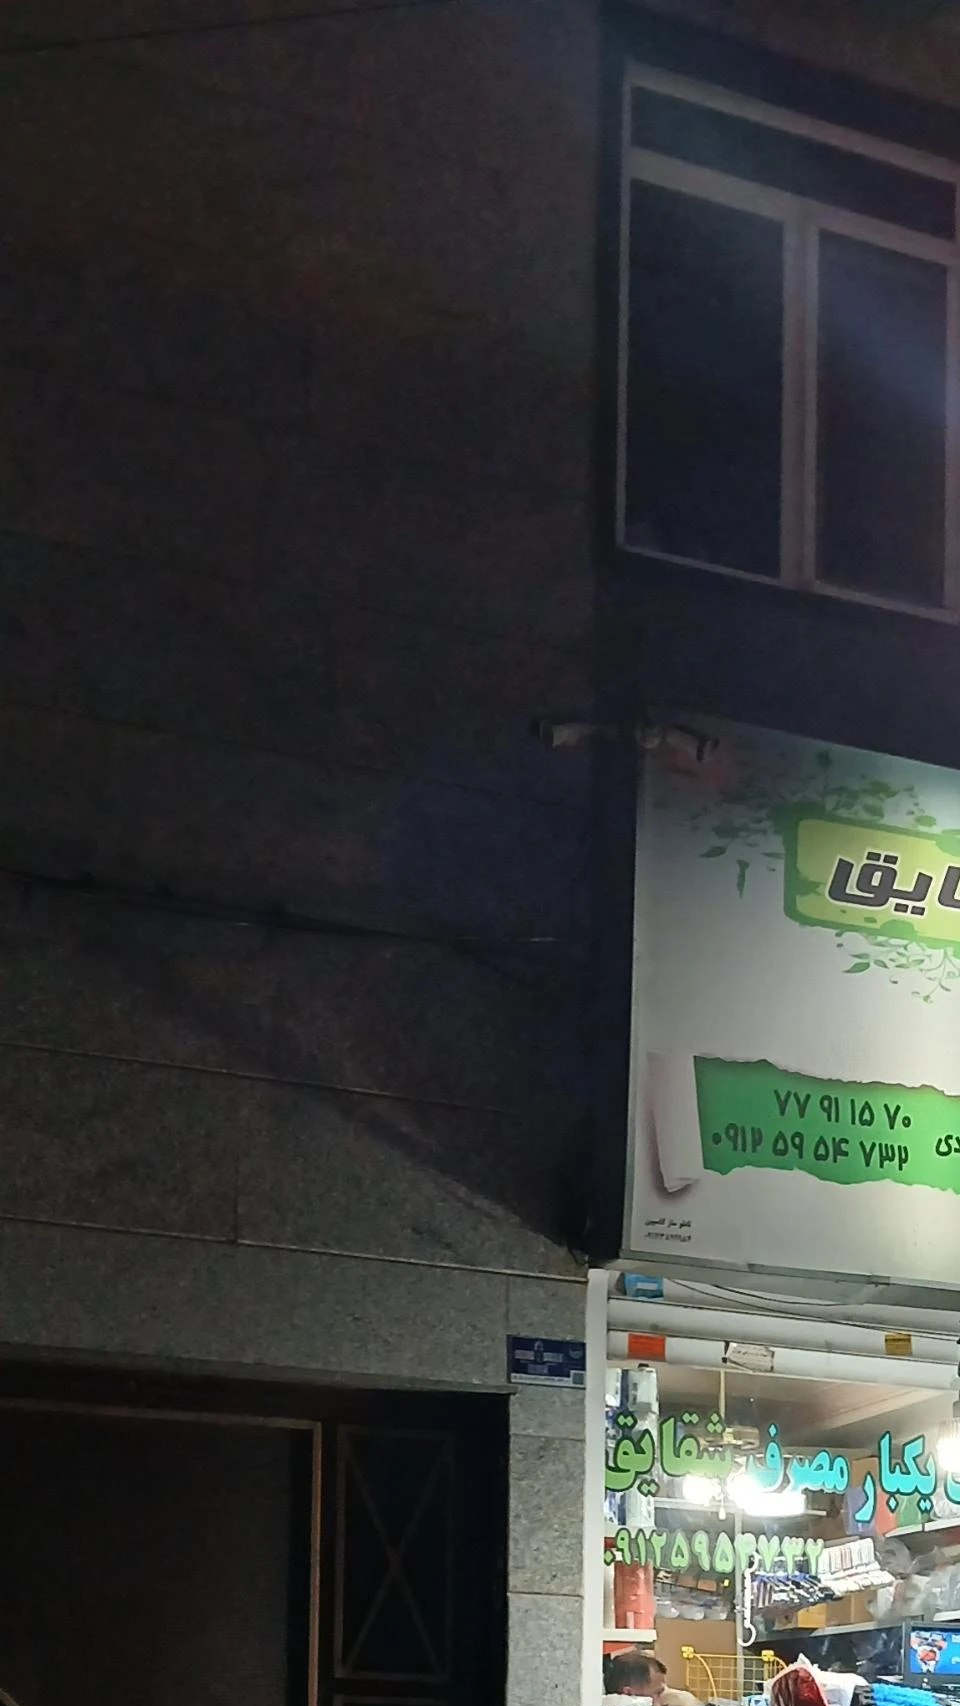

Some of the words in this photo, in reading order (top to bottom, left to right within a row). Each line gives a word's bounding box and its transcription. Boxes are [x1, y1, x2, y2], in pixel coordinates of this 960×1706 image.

[774, 1089, 811, 1119] ۷۷
[820, 1095, 840, 1123] ۹۱
[850, 1098, 875, 1127] ۱۵
[884, 1103, 912, 1130] ۷۰
[712, 1122, 763, 1153] ۰۹۱۲
[772, 1130, 804, 1159] ۵۹
[814, 1136, 849, 1163] ۵۴
[859, 1141, 909, 1171] ۷۳۲
[746, 1423, 850, 1494] مصرف
[854, 1430, 938, 1523] یکبار
